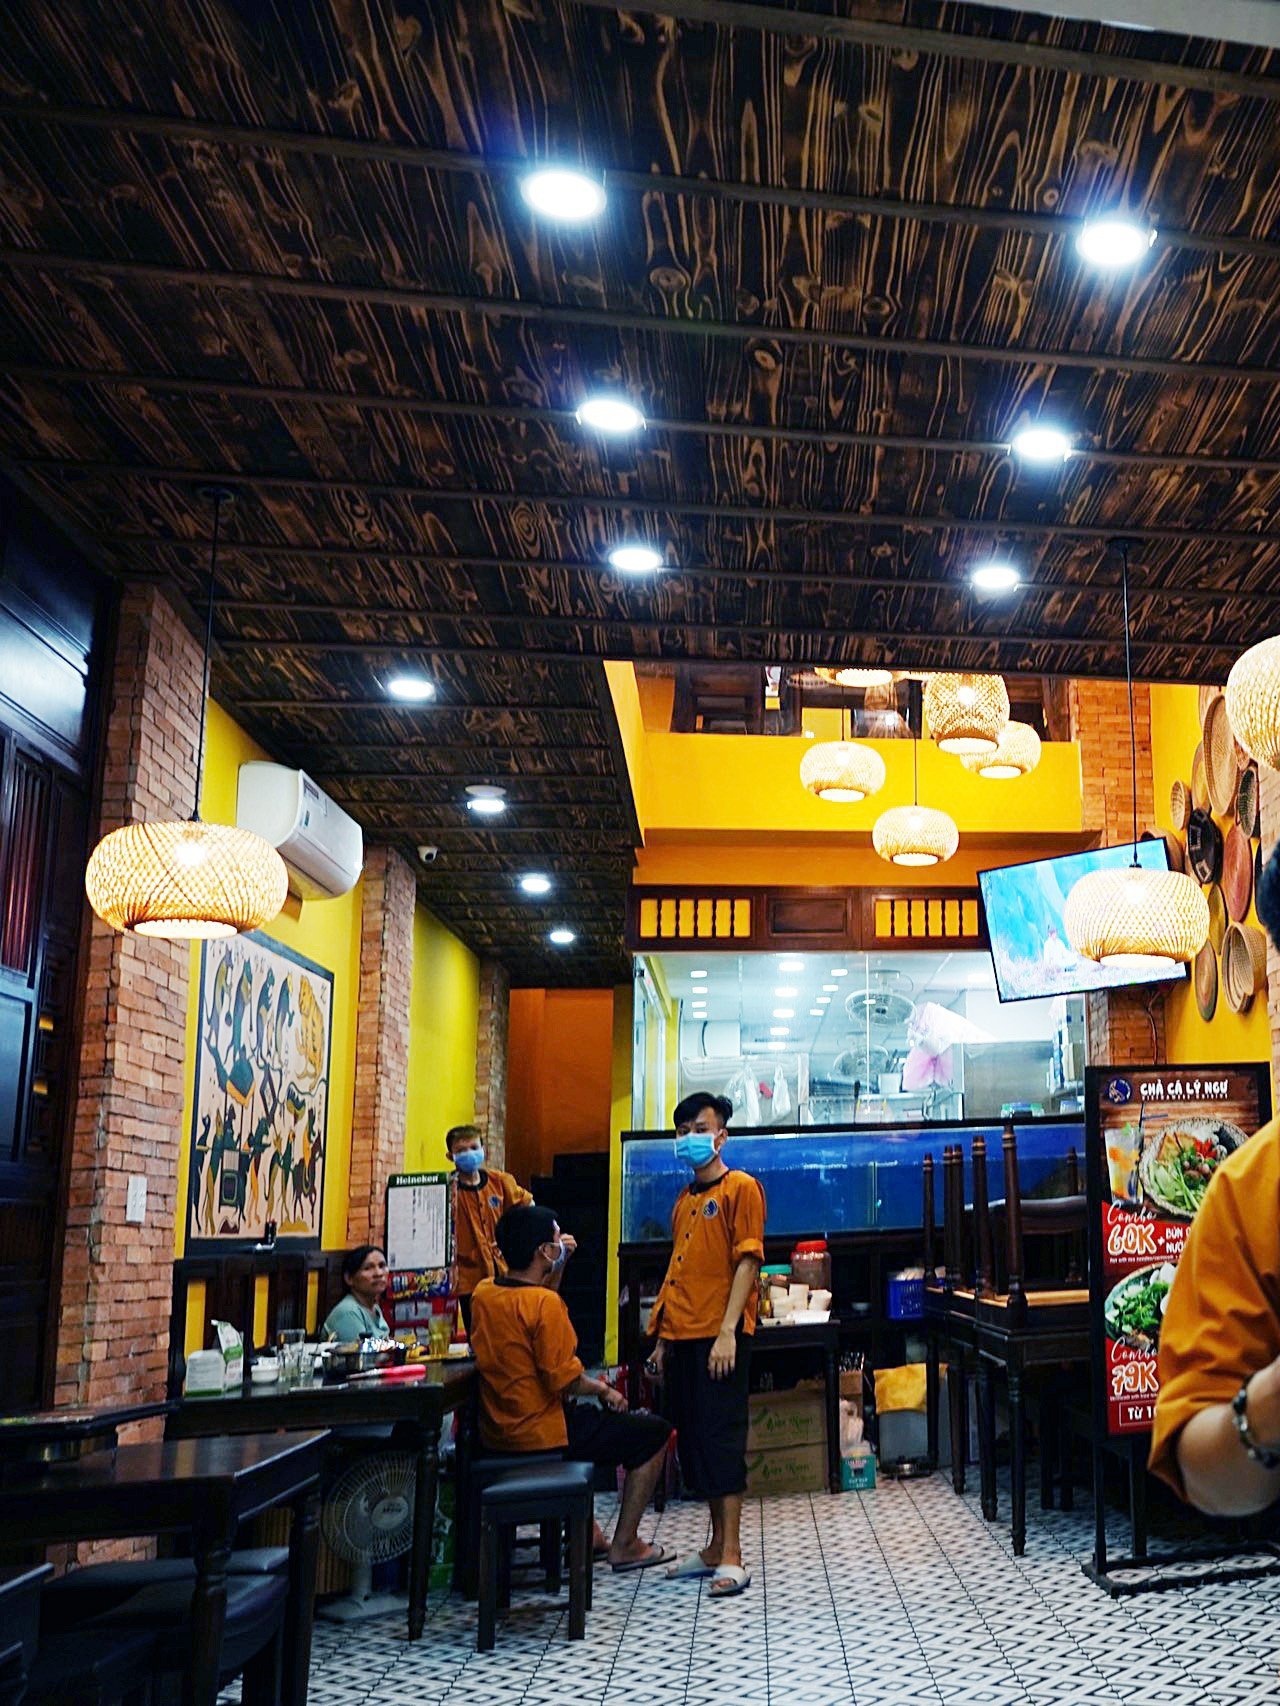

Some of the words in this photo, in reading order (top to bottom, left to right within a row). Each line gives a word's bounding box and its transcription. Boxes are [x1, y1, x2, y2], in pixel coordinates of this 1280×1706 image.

[1167, 1079, 1183, 1096] CÁ
[1186, 1079, 1201, 1095] LÝ
[1107, 1222, 1157, 1256] 60K
[1111, 1360, 1160, 1396] 79K
